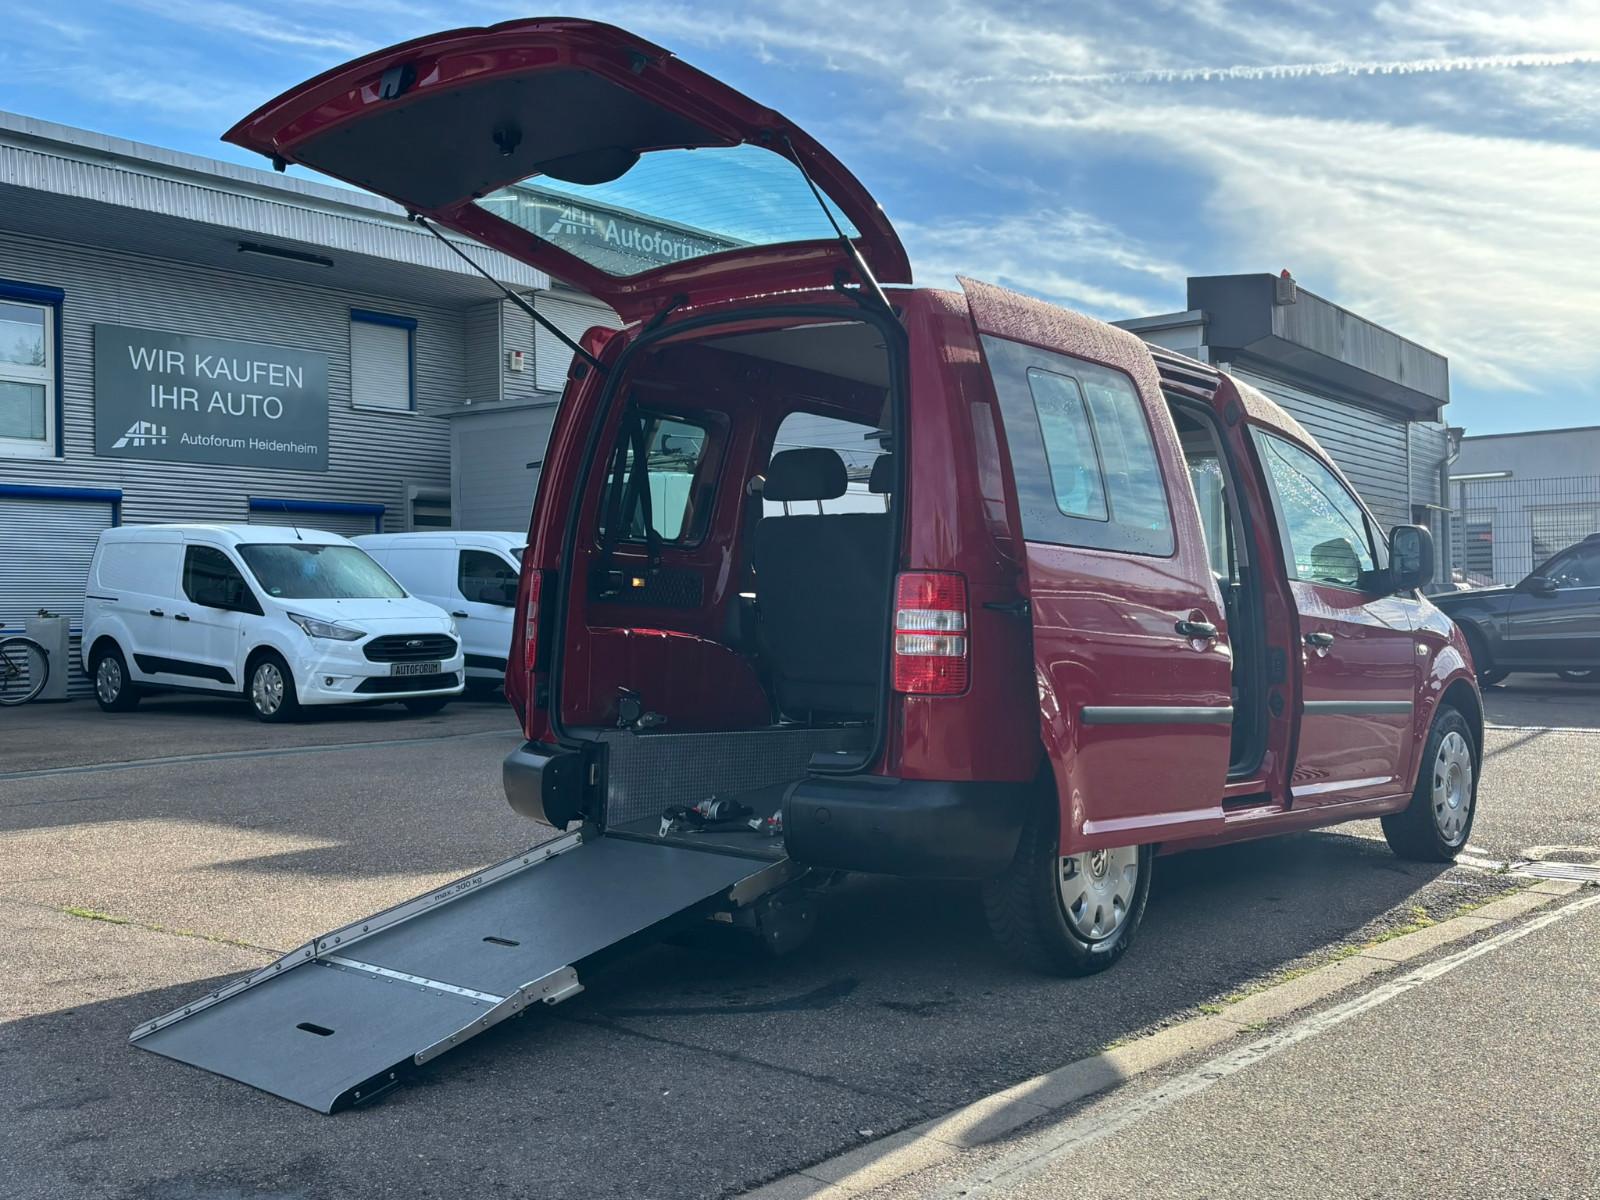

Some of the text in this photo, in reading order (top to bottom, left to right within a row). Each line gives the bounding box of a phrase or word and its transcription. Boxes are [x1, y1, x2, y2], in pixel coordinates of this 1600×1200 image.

[128, 345, 303, 389] WIR KAUFEN
[151, 384, 283, 420] IHR AUTO
[180, 432, 245, 449] Autoforum
[249, 438, 318, 455] Heidenheim
[396, 663, 438, 675] AUTOFORUM
[455, 881, 471, 892] 300
